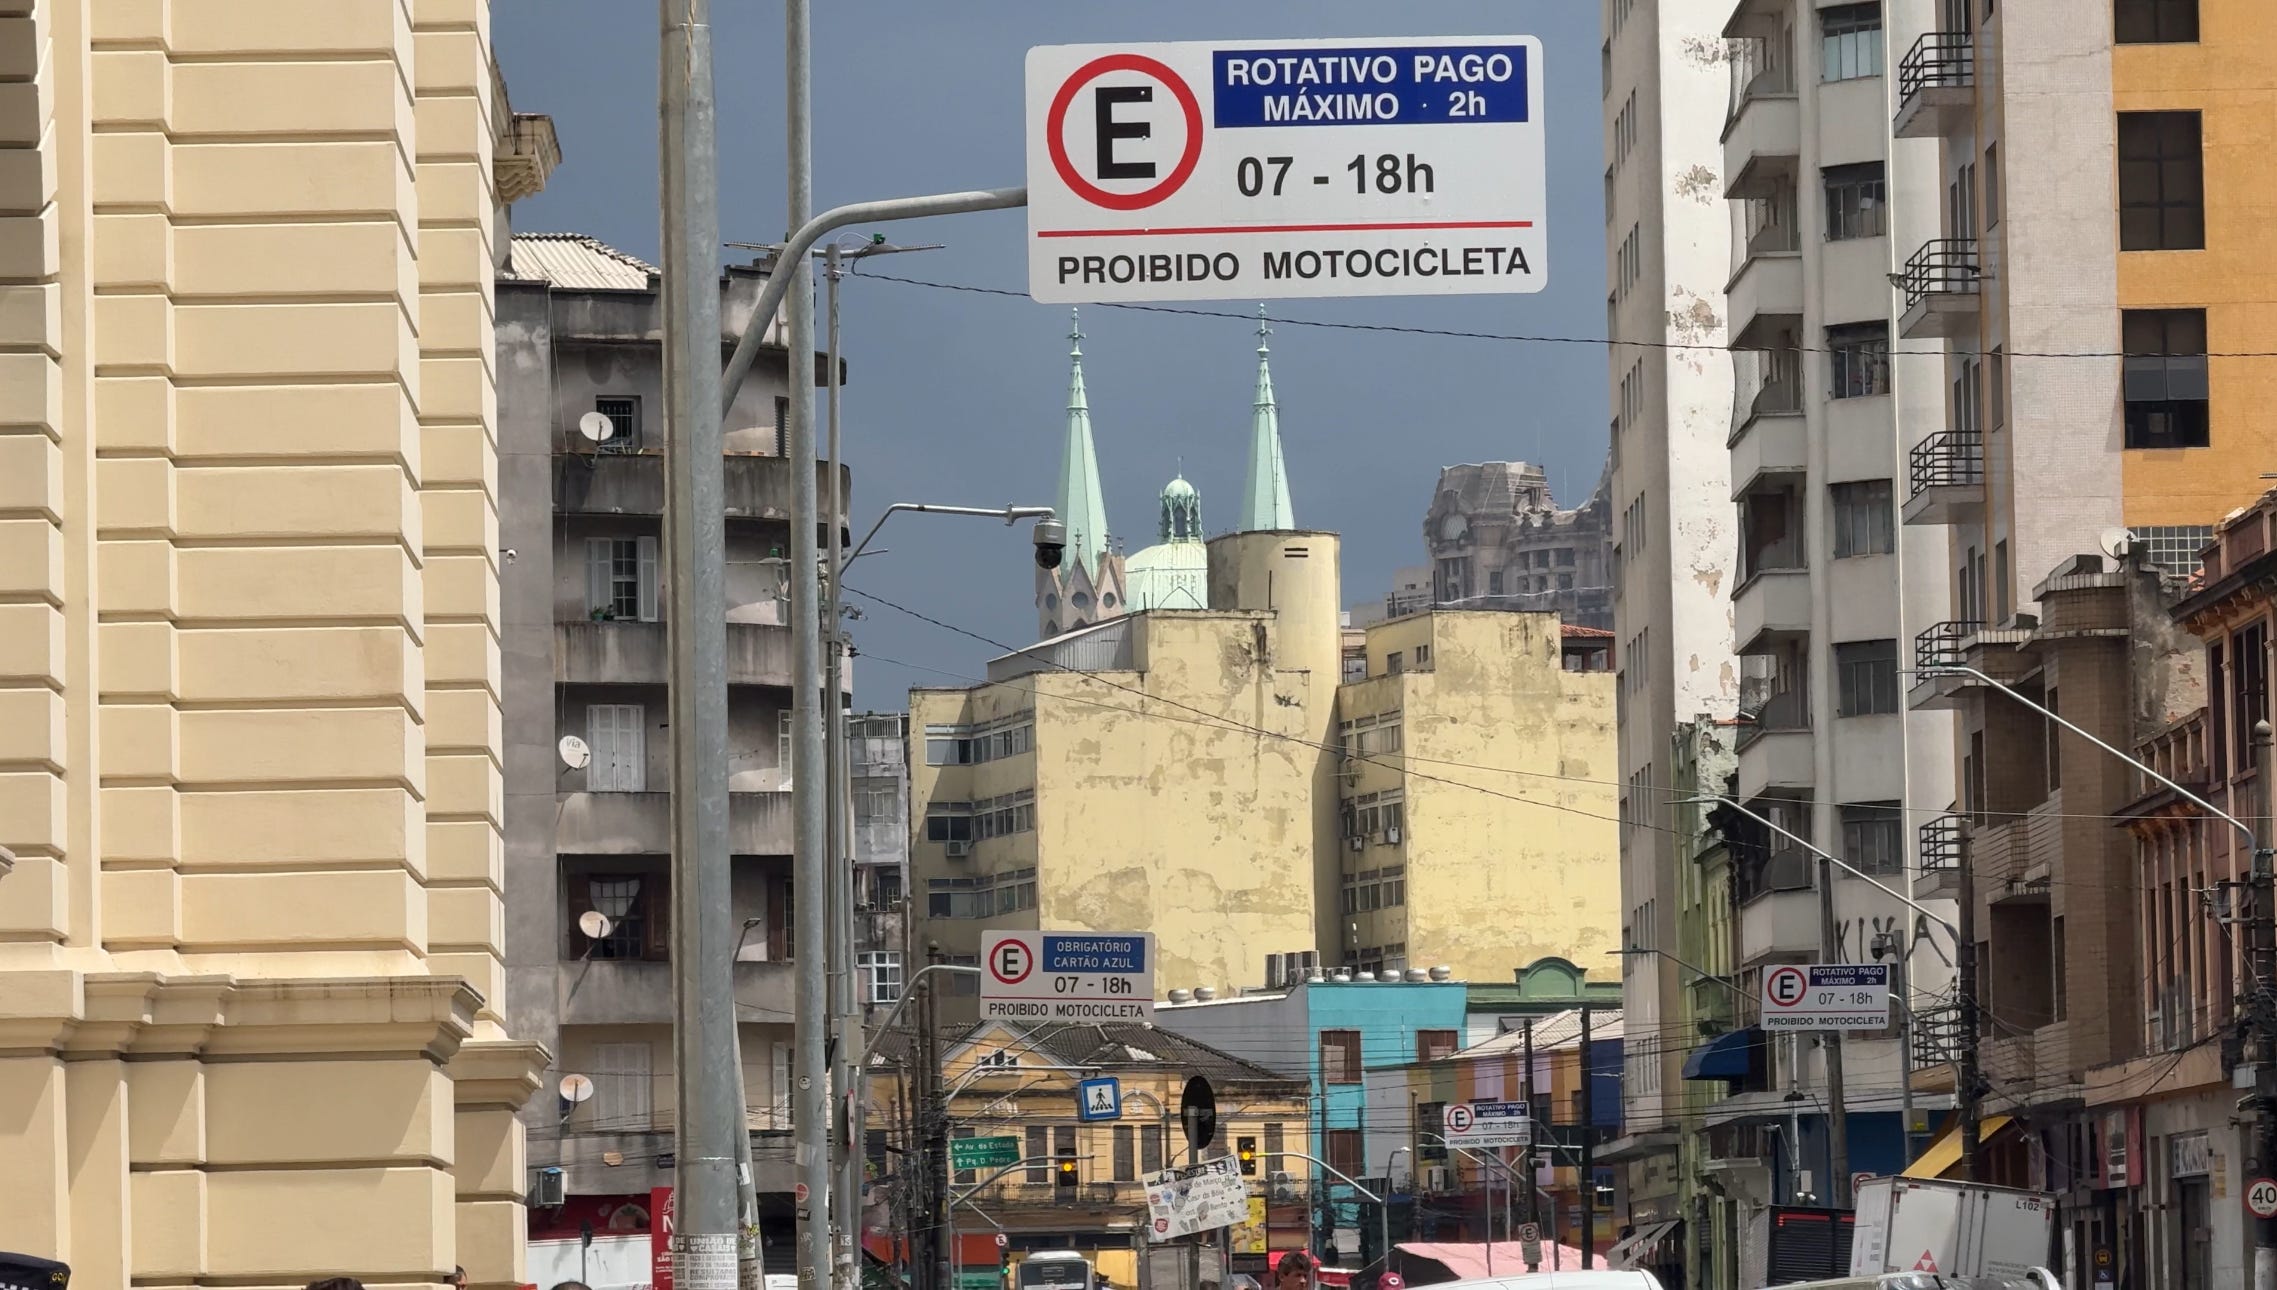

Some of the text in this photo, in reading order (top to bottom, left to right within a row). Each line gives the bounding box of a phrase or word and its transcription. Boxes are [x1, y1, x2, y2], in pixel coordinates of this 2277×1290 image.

[1227, 53, 1513, 86] ROTATIVO PAGO
[1264, 87, 1486, 121] MÁXIMO 2h
[1095, 86, 1156, 180] E
[1237, 153, 1435, 196] 07 - 18h
[1058, 247, 1531, 284] PROIBIDO MOTOCICLETA
[1057, 940, 1131, 953] OBRIGATÓRIO
[1002, 948, 1019, 975] E
[1054, 956, 1134, 968] CARTÃO AZUL
[1813, 967, 1884, 976] ROTATIVO PAGO
[1054, 976, 1079, 993] 07
[1102, 977, 1131, 993] 18h
[1779, 975, 1795, 999] E
[1821, 976, 1855, 985] MÁXIMO
[1818, 993, 1835, 1005] 07
[1849, 992, 1873, 1004] 18h
[989, 1003, 1144, 1017] PROIBIDO MOTOCICLETA
[1767, 1016, 1885, 1026] PROIBIDO MOTOCICLETA
[1455, 1111, 1466, 1127] E
[1482, 1122, 1492, 1130] 07
[1504, 1121, 1519, 1129] 18h
[1484, 1136, 1528, 1144] MOTOCICLETA
[2252, 1187, 2276, 1203] 40
[2016, 1200, 2040, 1212] L102
[1526, 1228, 1533, 1238] E
